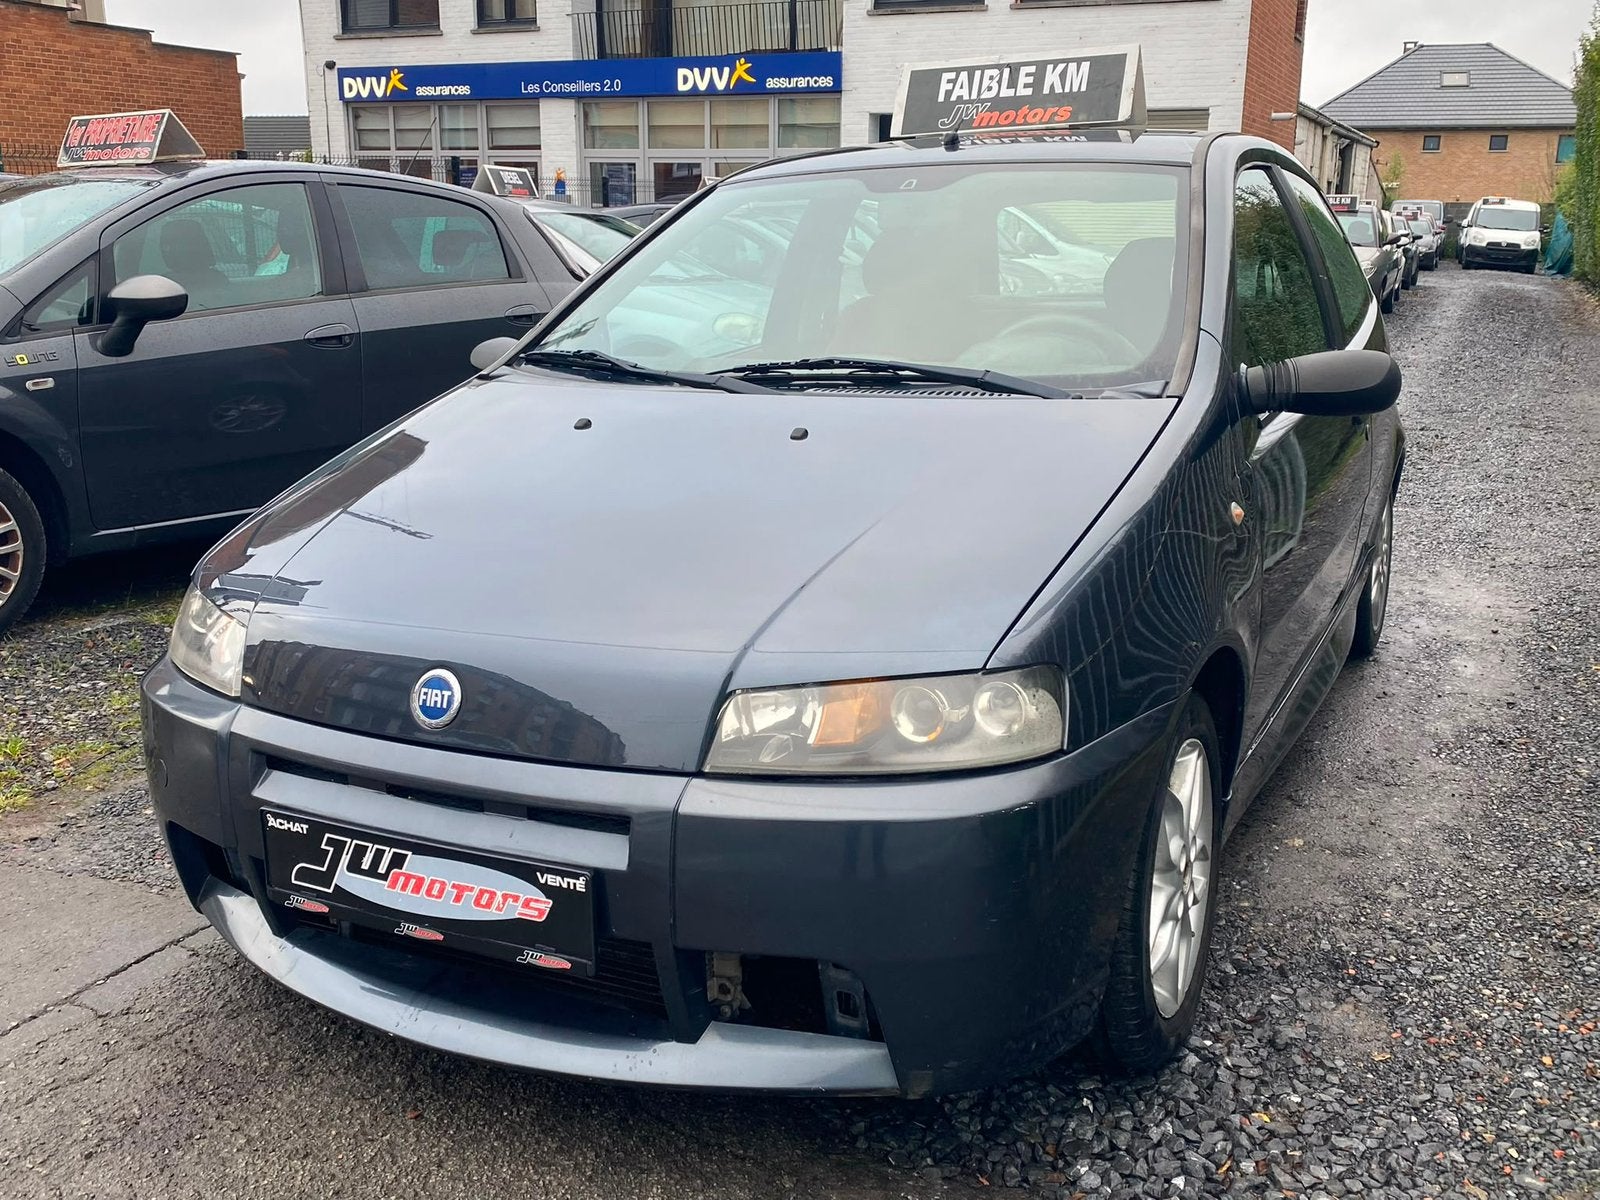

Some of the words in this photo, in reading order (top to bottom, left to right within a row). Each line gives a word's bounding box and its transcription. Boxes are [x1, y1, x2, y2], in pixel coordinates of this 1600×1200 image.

[342, 76, 386, 98] DVV
[415, 83, 471, 97] assurances
[521, 81, 540, 93] Les
[542, 79, 602, 93] Conseillers
[603, 79, 622, 92] 2.0
[676, 66, 730, 92] DVV
[765, 75, 834, 89] assurances
[937, 65, 1037, 103] FAIBLE
[1042, 60, 1091, 95] KM
[419, 687, 452, 709] FIAT
[267, 816, 309, 834] ACHAT
